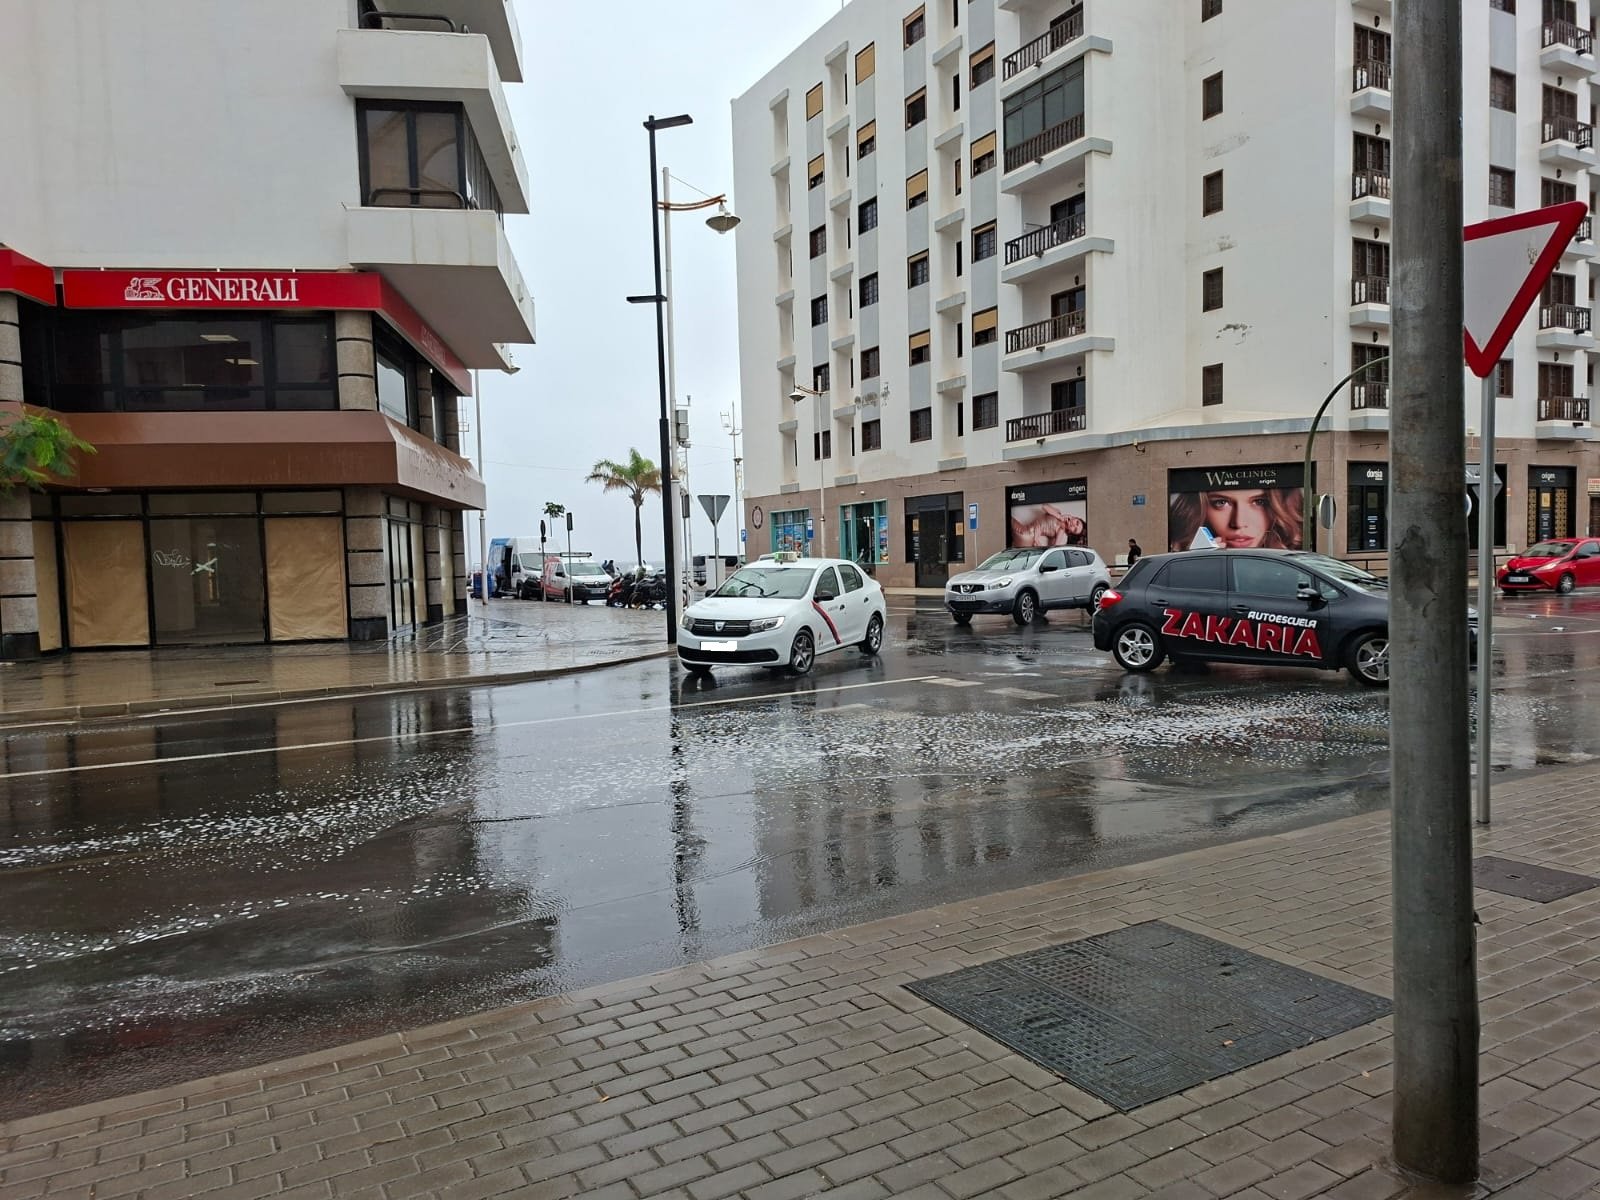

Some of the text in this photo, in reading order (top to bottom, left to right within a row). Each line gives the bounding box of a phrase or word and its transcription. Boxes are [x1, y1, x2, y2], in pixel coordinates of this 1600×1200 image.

[166, 277, 299, 301] GENERALI
[1235, 470, 1277, 479] CLINICS
[1366, 468, 1383, 478] dorsia
[1247, 610, 1318, 629] AUTOESCUELA
[1161, 608, 1323, 660] ZAKARIA
